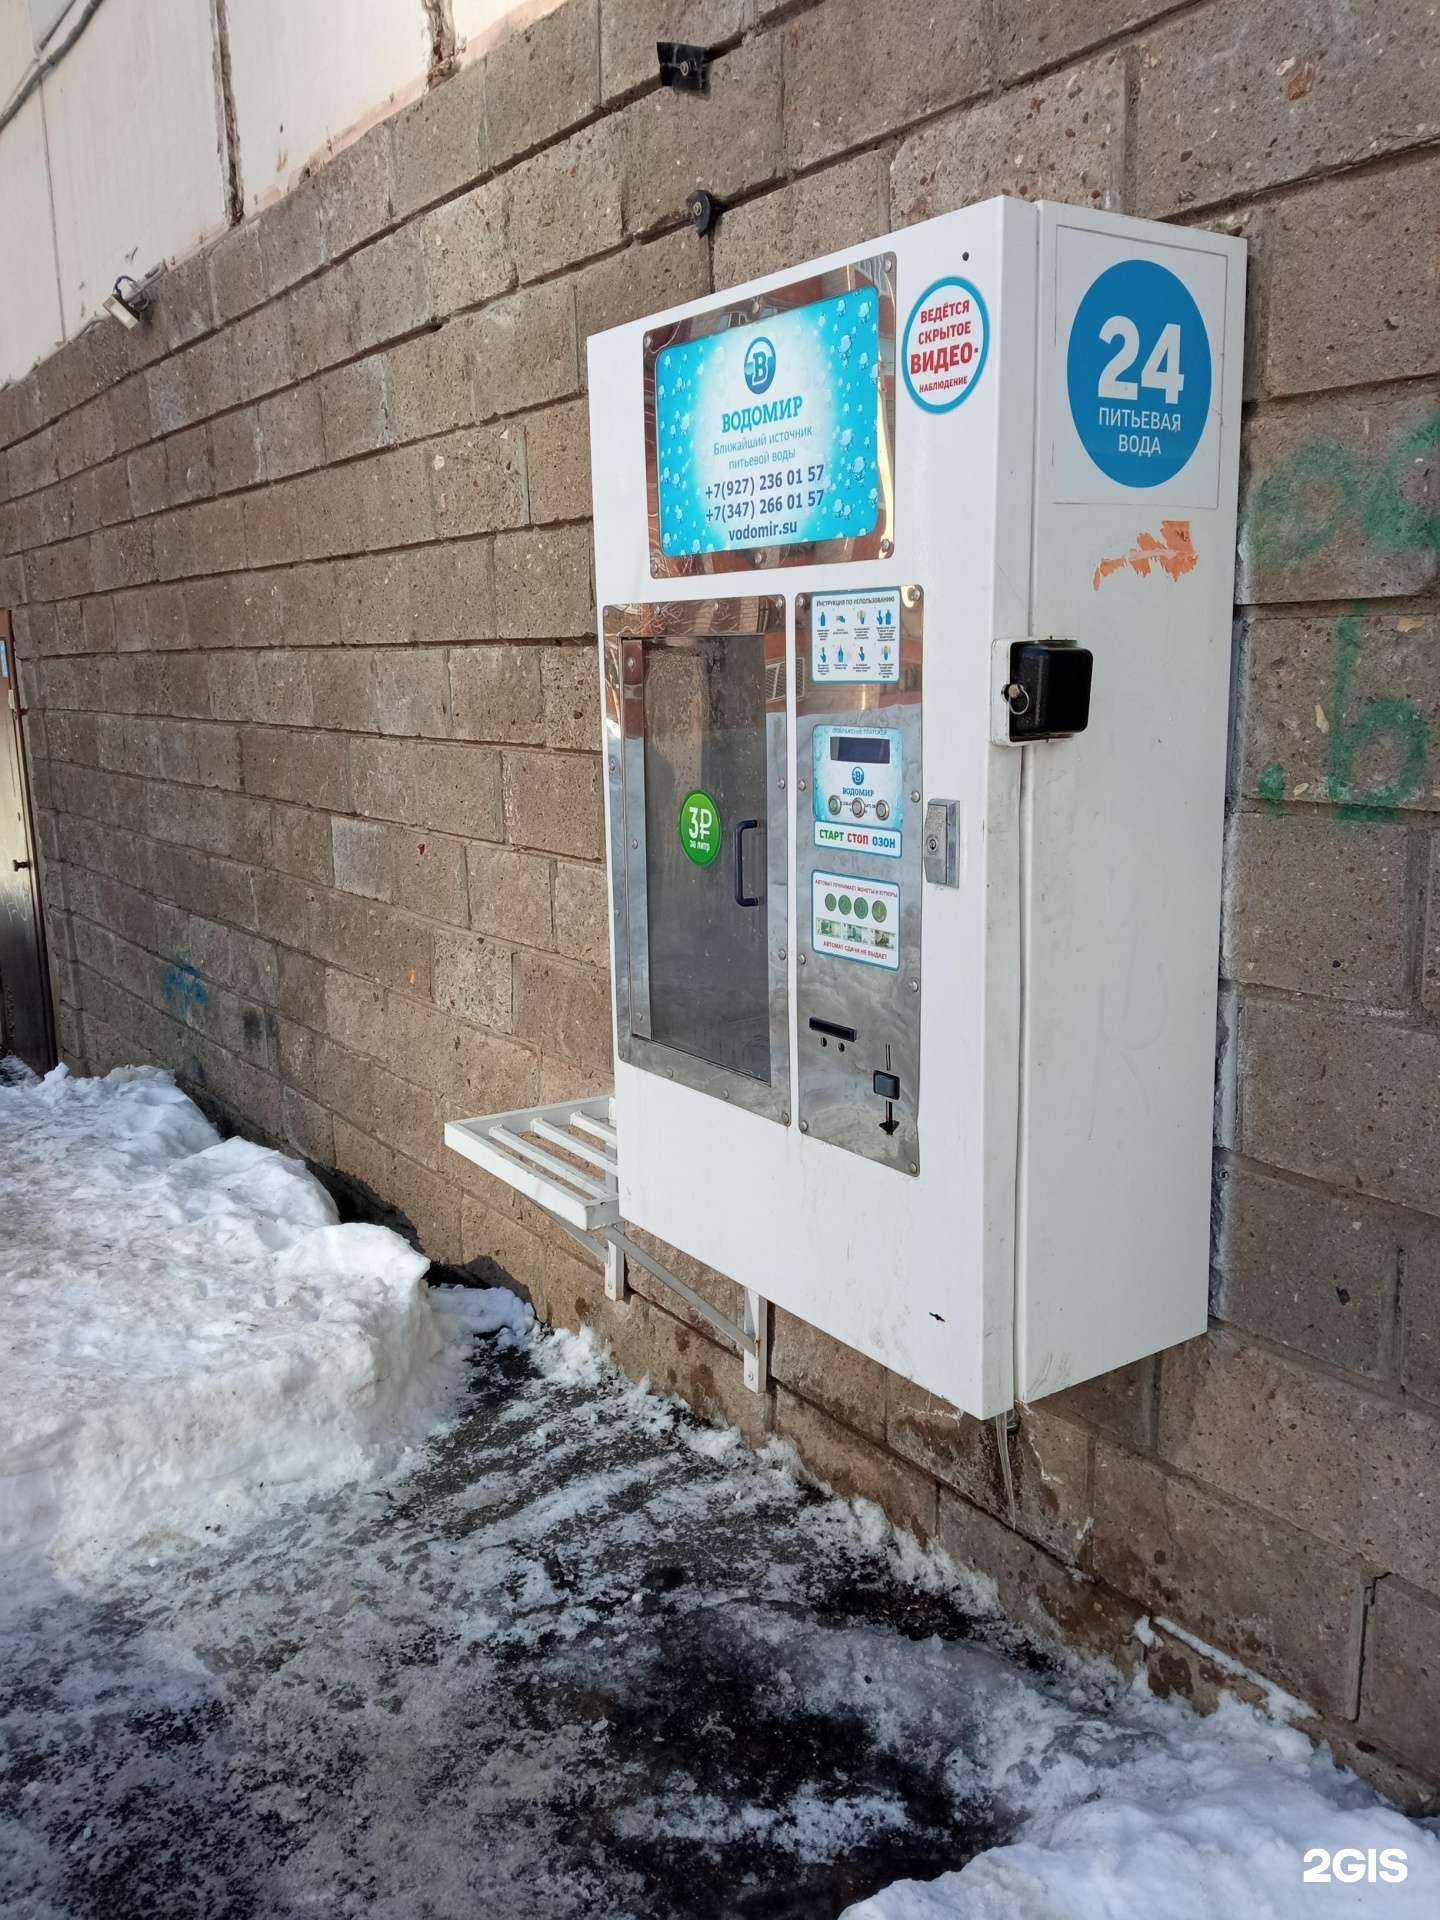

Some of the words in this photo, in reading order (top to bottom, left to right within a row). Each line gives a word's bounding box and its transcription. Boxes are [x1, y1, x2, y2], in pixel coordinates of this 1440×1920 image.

[920, 299, 970, 324] ВЕДЁТСЯ
[918, 321, 971, 345] СКРЫТОЕ
[910, 341, 979, 375] ВИДЕО-
[1097, 314, 1185, 405] 24
[918, 376, 968, 393] НАБЛЮДЕНИЕ
[721, 396, 803, 433] ВОДОМИР
[1098, 407, 1181, 432] ПИТЬЕВАЯ
[713, 435, 767, 456] Ближайший
[768, 427, 813, 446] источник
[1118, 434, 1162, 457] ВОДА
[729, 452, 770, 470] питьевой
[772, 448, 796, 464] воды
[705, 473, 755, 500] +7(927)
[759, 472, 783, 491] 236
[786, 468, 803, 487] 01
[807, 464, 825, 483] 57
[705, 499, 755, 524] +7(347)
[759, 496, 783, 515] 266
[786, 493, 803, 511] 01
[807, 489, 825, 507] 57
[728, 519, 797, 541] vodomir.su
[842, 787, 874, 797] ВОДОМИР
[819, 829, 845, 842] СТАРТ
[847, 832, 869, 845] СТОП
[872, 836, 896, 849] ОЗОН
